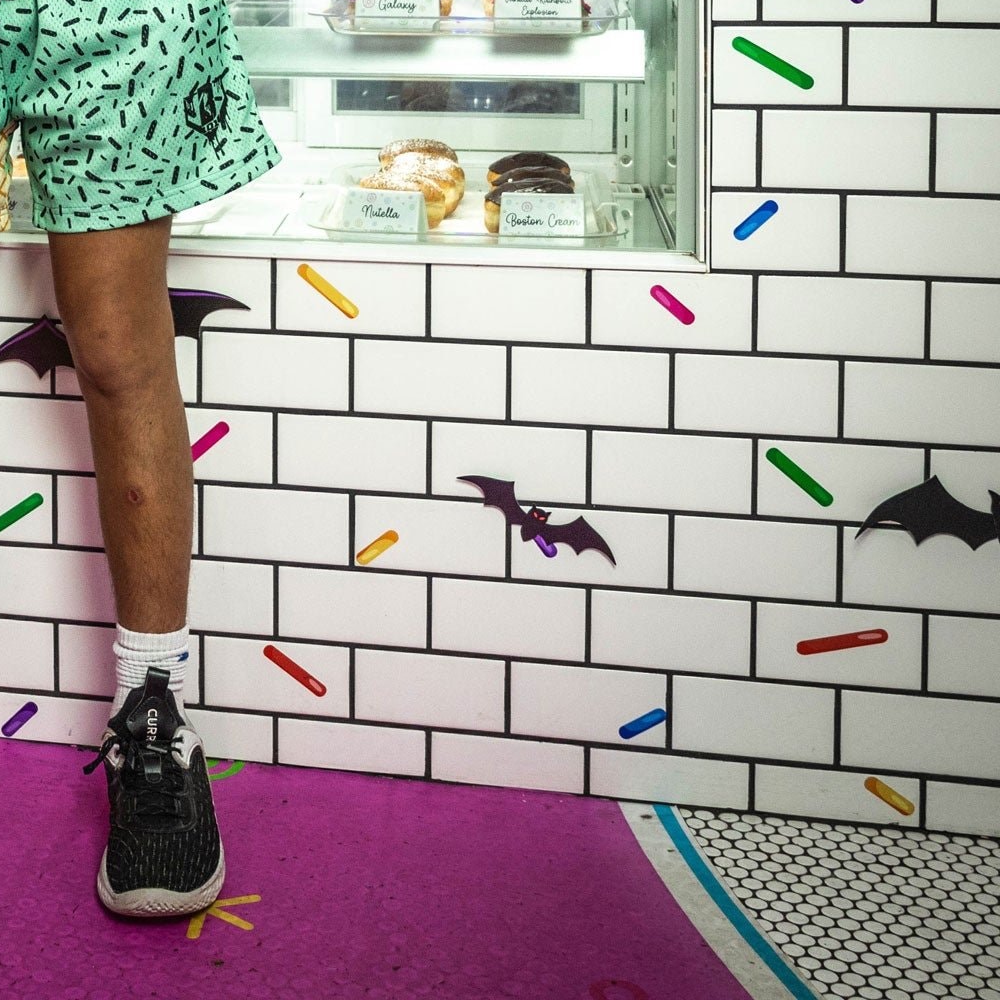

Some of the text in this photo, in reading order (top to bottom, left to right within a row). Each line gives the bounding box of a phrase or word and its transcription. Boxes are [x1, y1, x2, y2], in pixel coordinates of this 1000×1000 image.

[521, 5, 559, 17] Explosion
[362, 205, 400, 219] Nutella
[506, 213, 580, 227] Boston Cream
